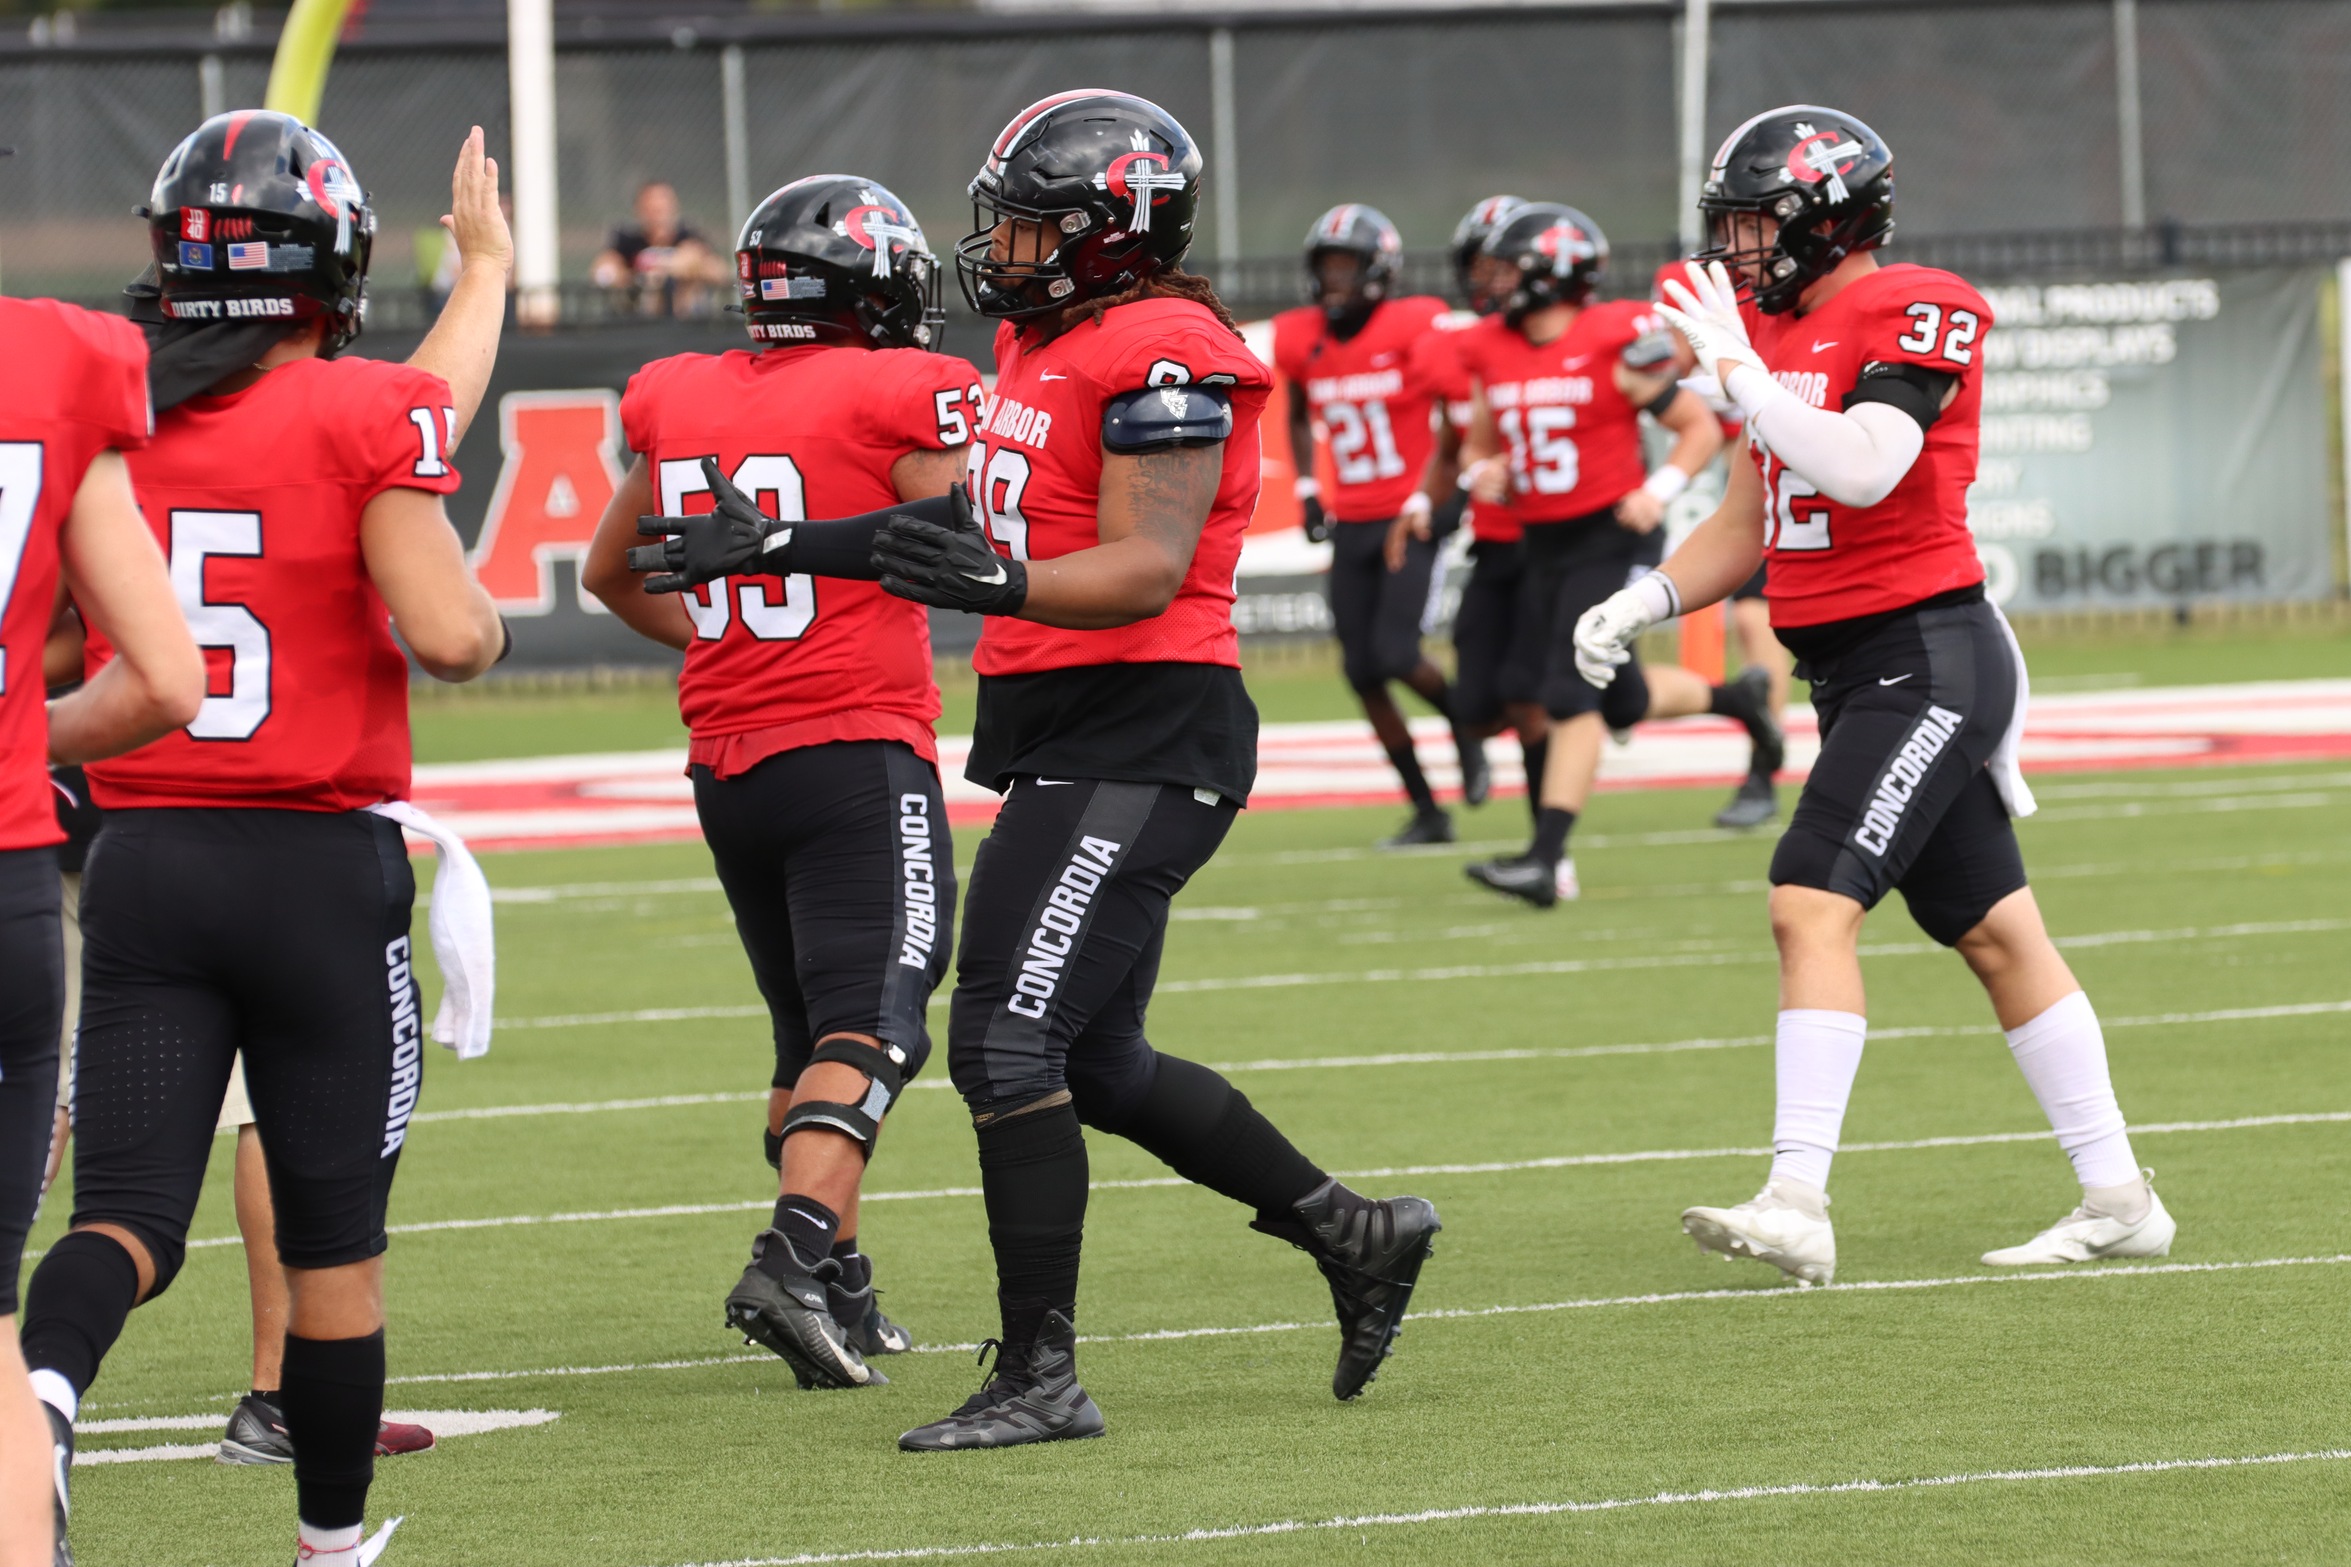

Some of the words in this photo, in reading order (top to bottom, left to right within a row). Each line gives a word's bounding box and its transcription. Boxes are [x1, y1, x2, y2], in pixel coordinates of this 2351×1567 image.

[209, 183, 228, 203] 15
[749, 230, 763, 246] 53
[171, 300, 222, 318] DIRTY
[226, 298, 294, 316] BIRDS
[766, 324, 816, 338] BIRDS
[1898, 302, 1979, 366] 32
[990, 398, 1052, 449] ARBOR
[1322, 399, 1407, 485] 21
[1499, 405, 1579, 495] 15
[463, 387, 624, 617] A
[2034, 543, 2266, 602] BIGGER
[168, 507, 272, 742] 5
[1854, 704, 1964, 857] CONCORDIA
[898, 793, 937, 970] CONCORDIA
[1007, 835, 1122, 1019] CONCORDIA
[380, 934, 420, 1160] CONCORDIA
